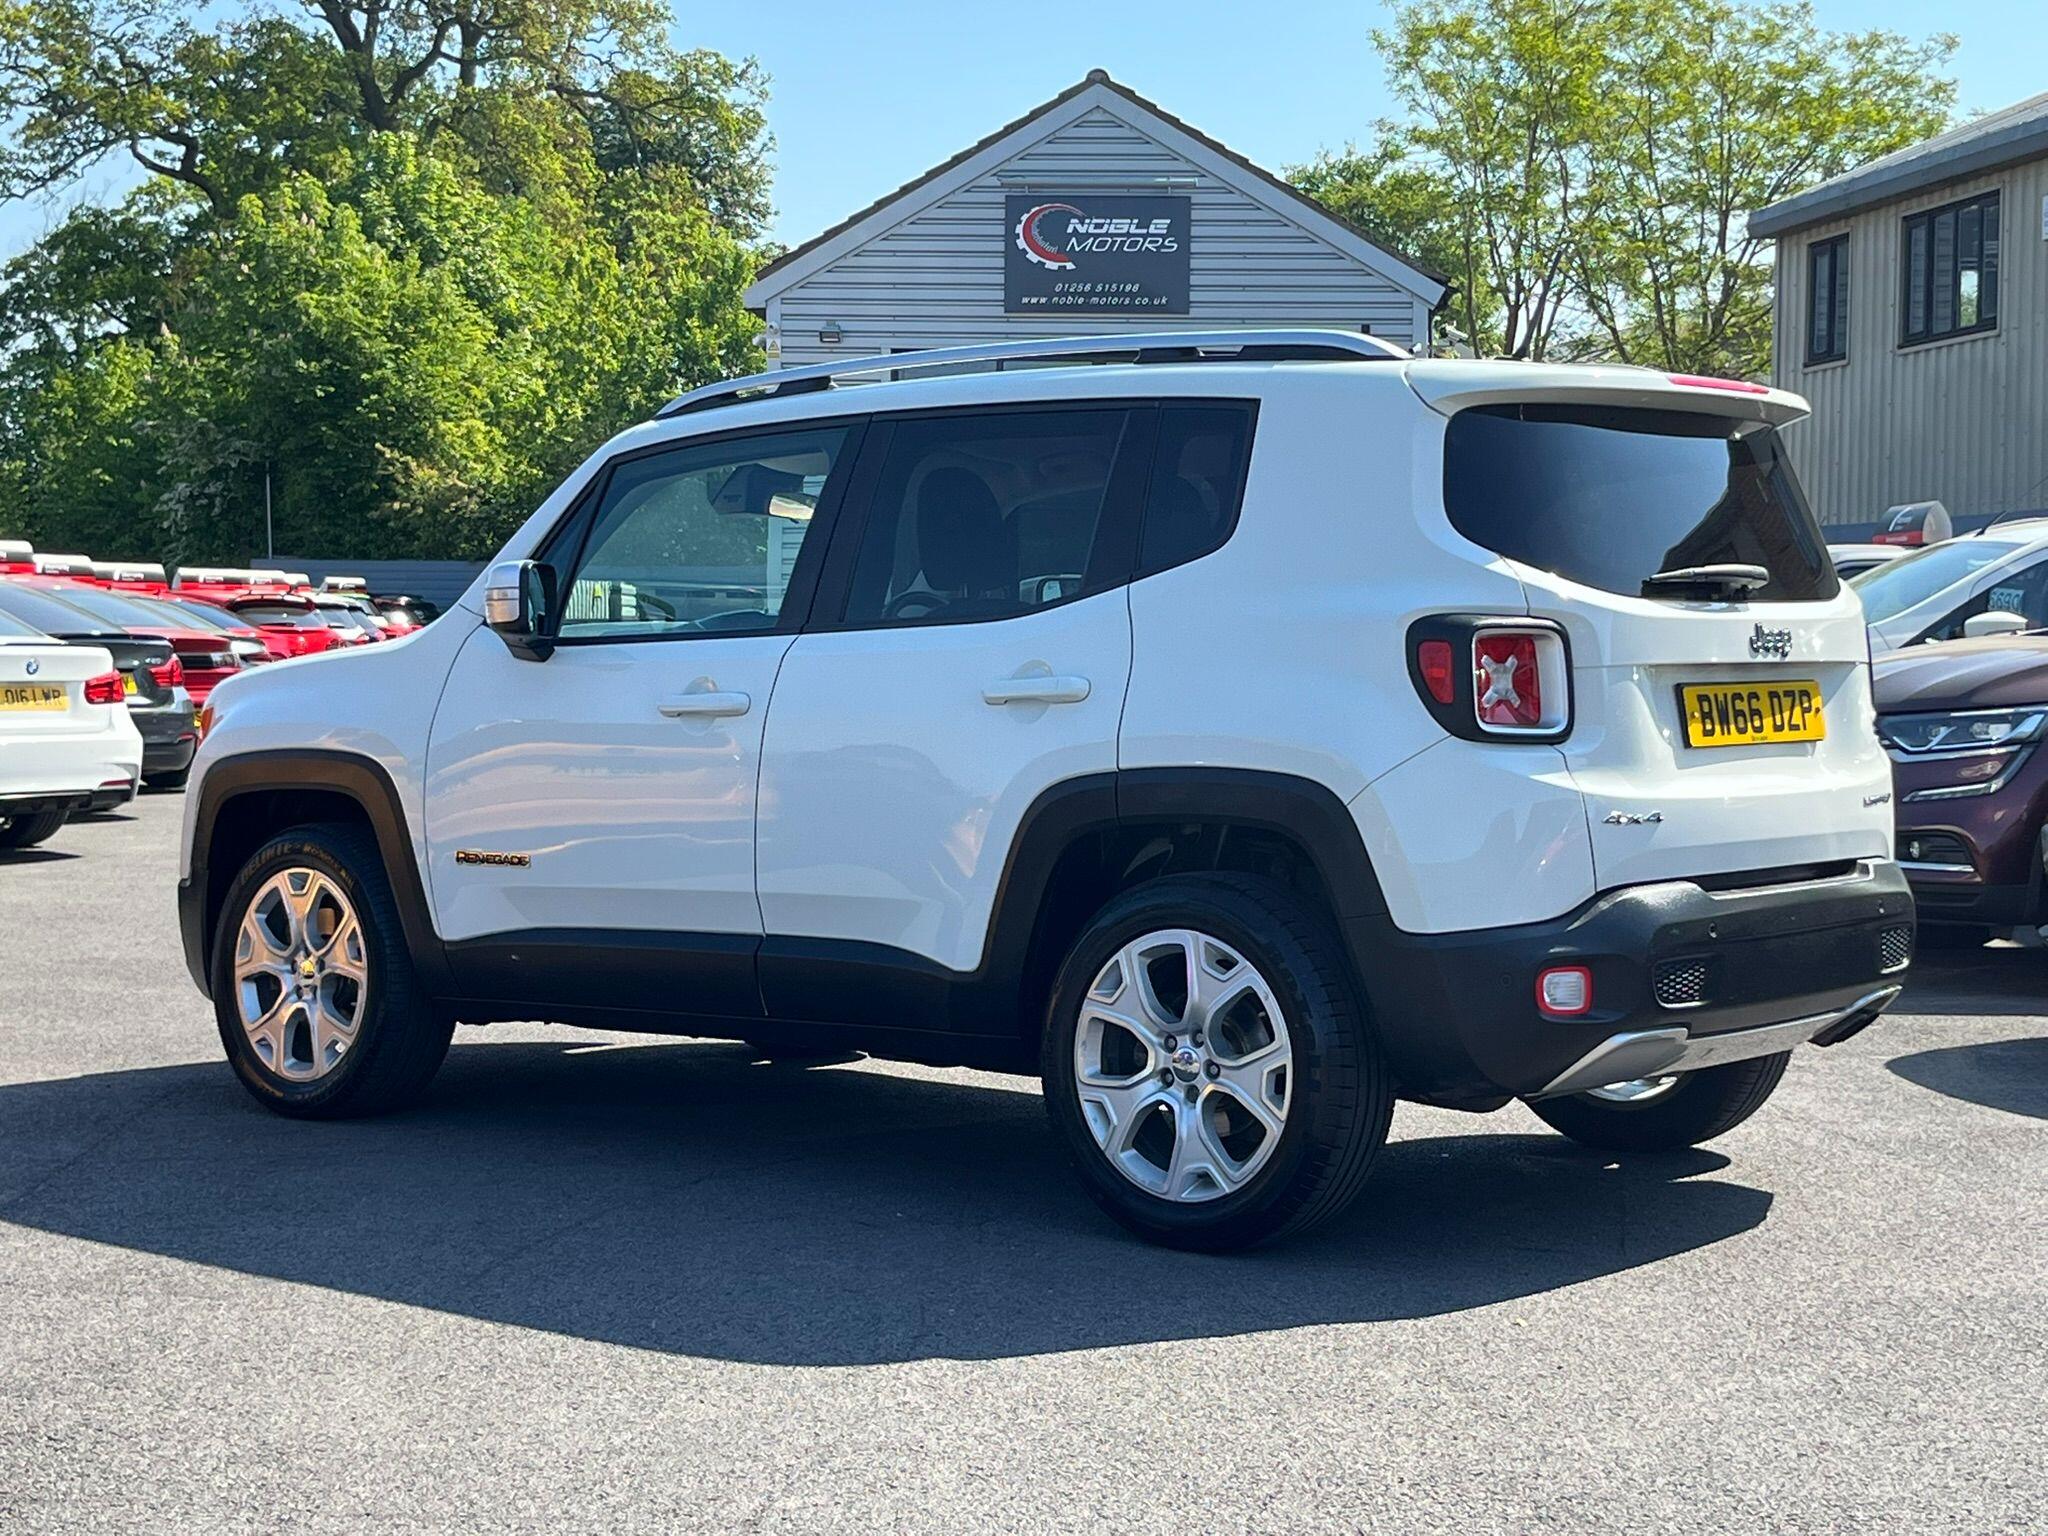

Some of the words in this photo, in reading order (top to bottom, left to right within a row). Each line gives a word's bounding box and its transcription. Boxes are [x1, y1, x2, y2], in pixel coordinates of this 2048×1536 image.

[1066, 218, 1171, 234] NOBLE
[1065, 237, 1179, 252] MOTORS
[1054, 283, 1091, 293] 01256
[1697, 692, 1764, 738] BW66
[1767, 689, 1813, 733] DZP
[455, 850, 531, 867] RENEGADE
